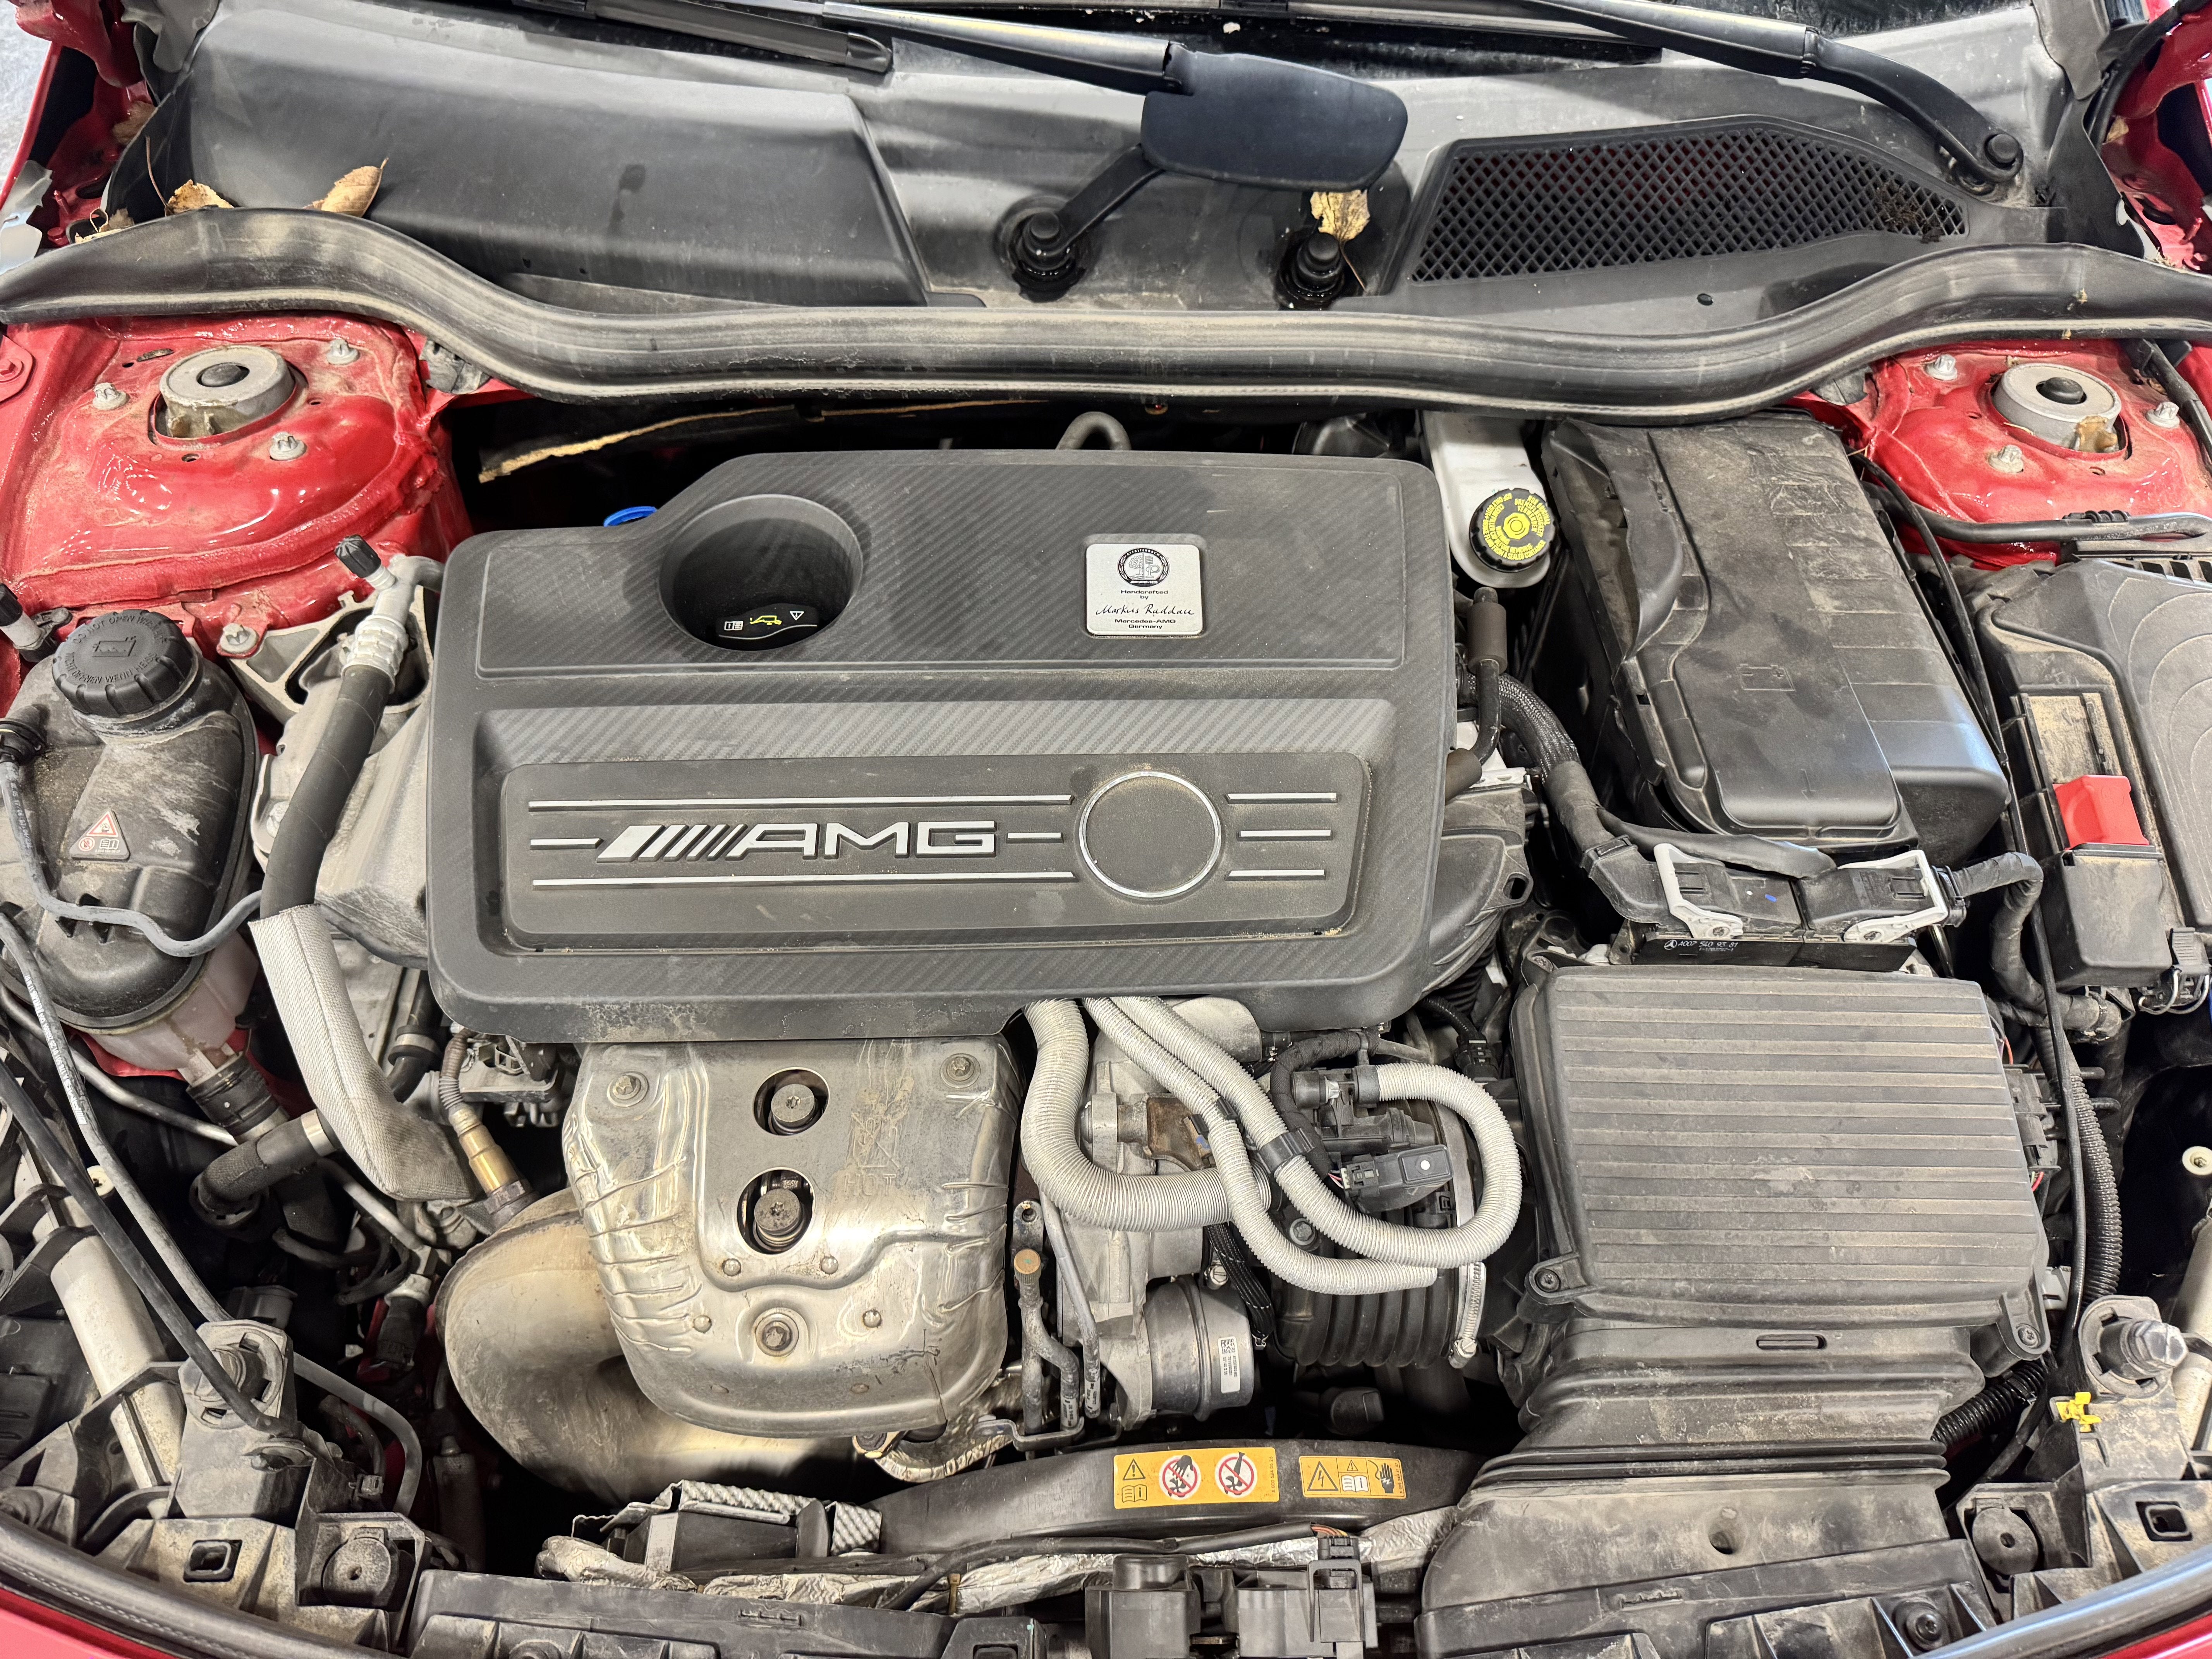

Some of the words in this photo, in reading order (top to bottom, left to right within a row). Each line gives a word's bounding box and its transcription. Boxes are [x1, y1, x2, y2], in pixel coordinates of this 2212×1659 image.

[1492, 496, 1504, 506] ONLY
[1492, 504, 1504, 516] CLEAN
[1527, 495, 1539, 504] NUR
[1536, 503, 1551, 526] ORIGINAL
[1484, 534, 1494, 547] FLUID
[1490, 531, 1498, 540] CAP
[1491, 544, 1504, 556] FROM
[1494, 538, 1510, 552] BEFORE
[1510, 543, 1534, 554] REMOVING
[1524, 540, 1546, 558] CONTAINER
[1096, 605, 1139, 615] Markus
[73, 634, 86, 643] DO
[87, 621, 105, 633] NOT
[109, 616, 135, 624] OPEN
[105, 669, 132, 683] WENN
[725, 821, 996, 860] AMG
